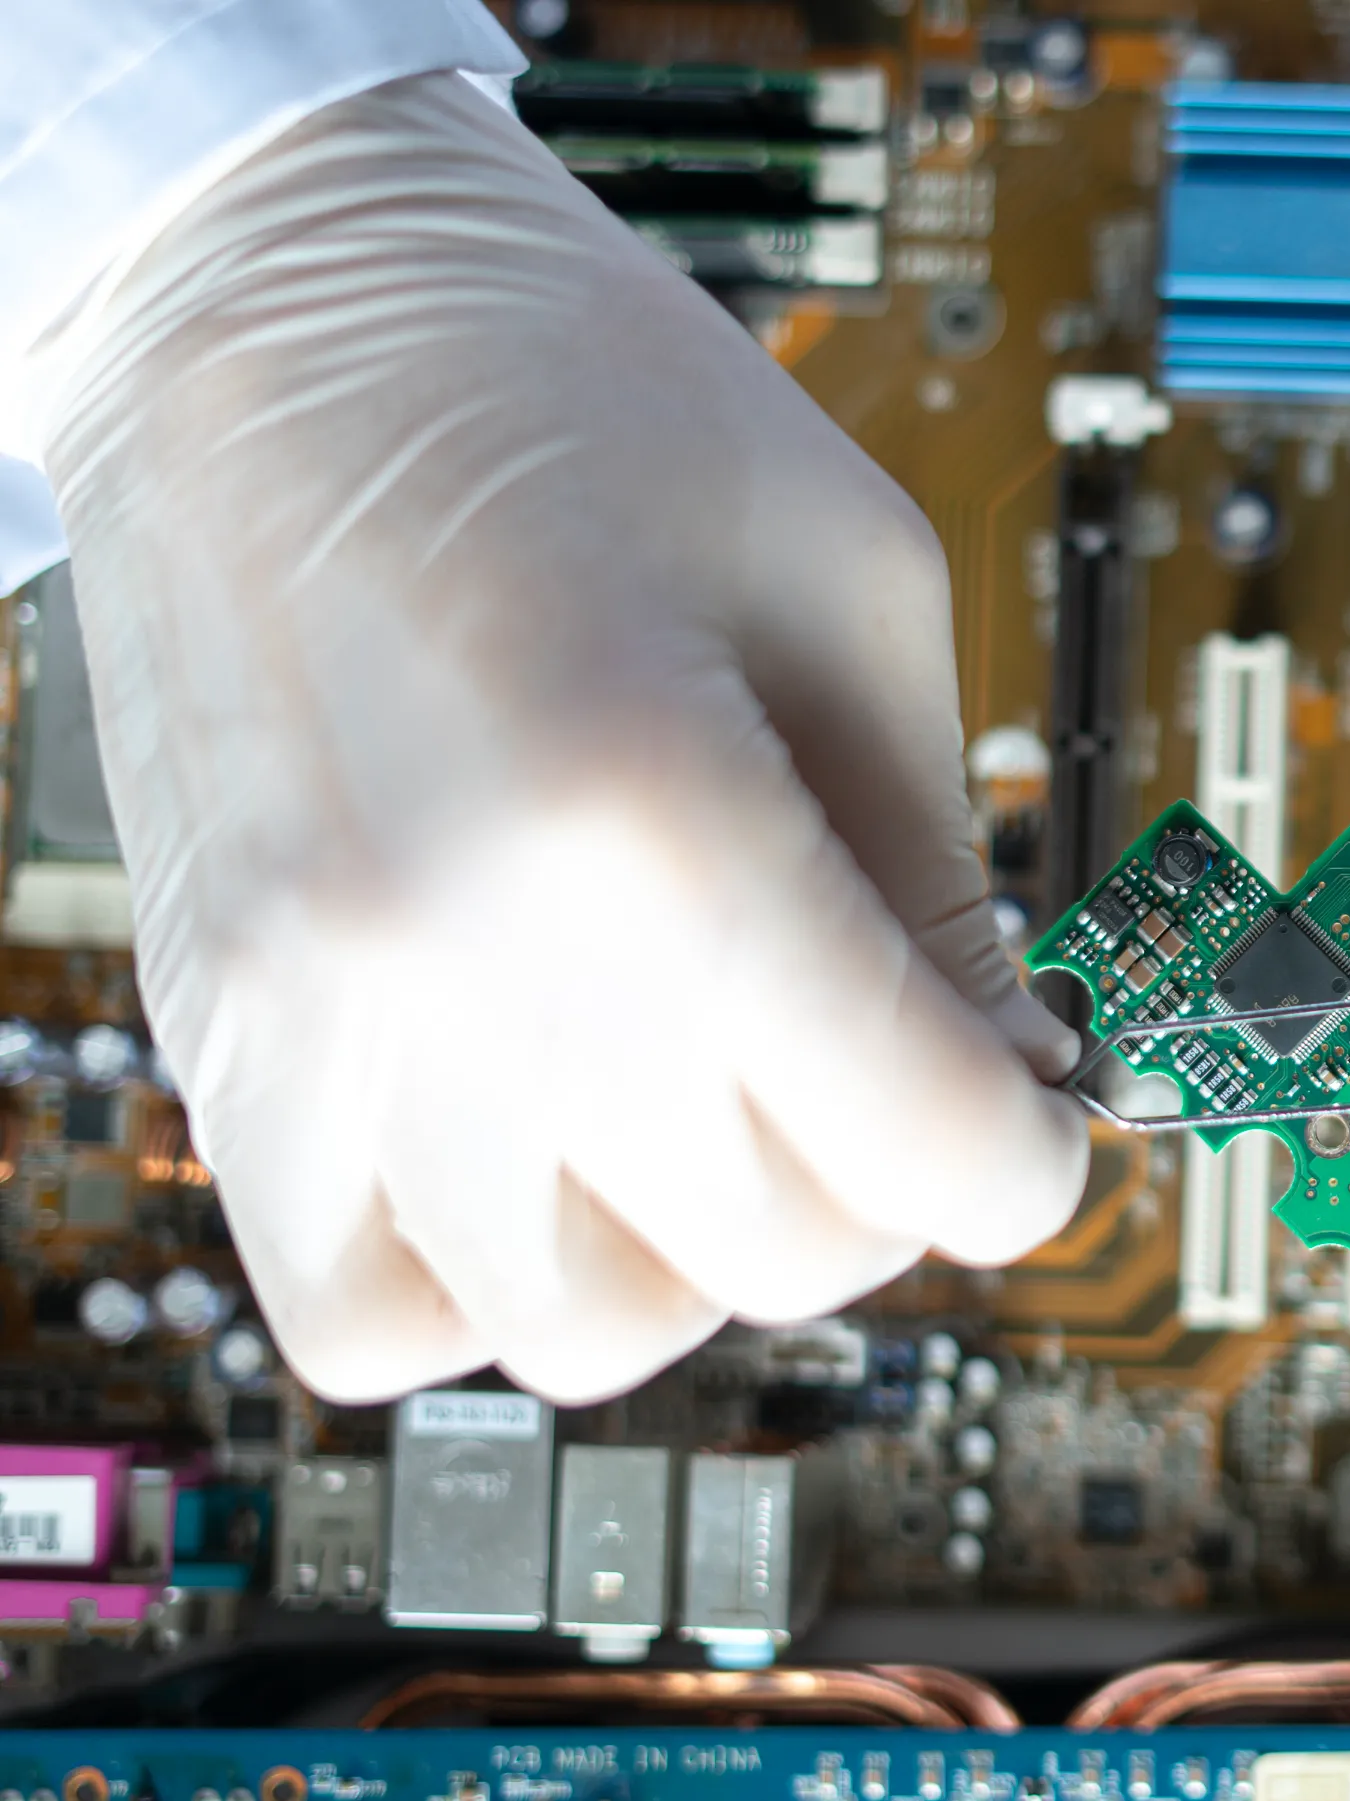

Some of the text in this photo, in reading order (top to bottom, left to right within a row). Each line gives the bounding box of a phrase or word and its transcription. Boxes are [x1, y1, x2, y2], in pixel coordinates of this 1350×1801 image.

[1174, 848, 1196, 881] 100
[552, 1745, 619, 1775] MADE
[634, 1745, 668, 1774] IN
[679, 1744, 763, 1775] CHINA
